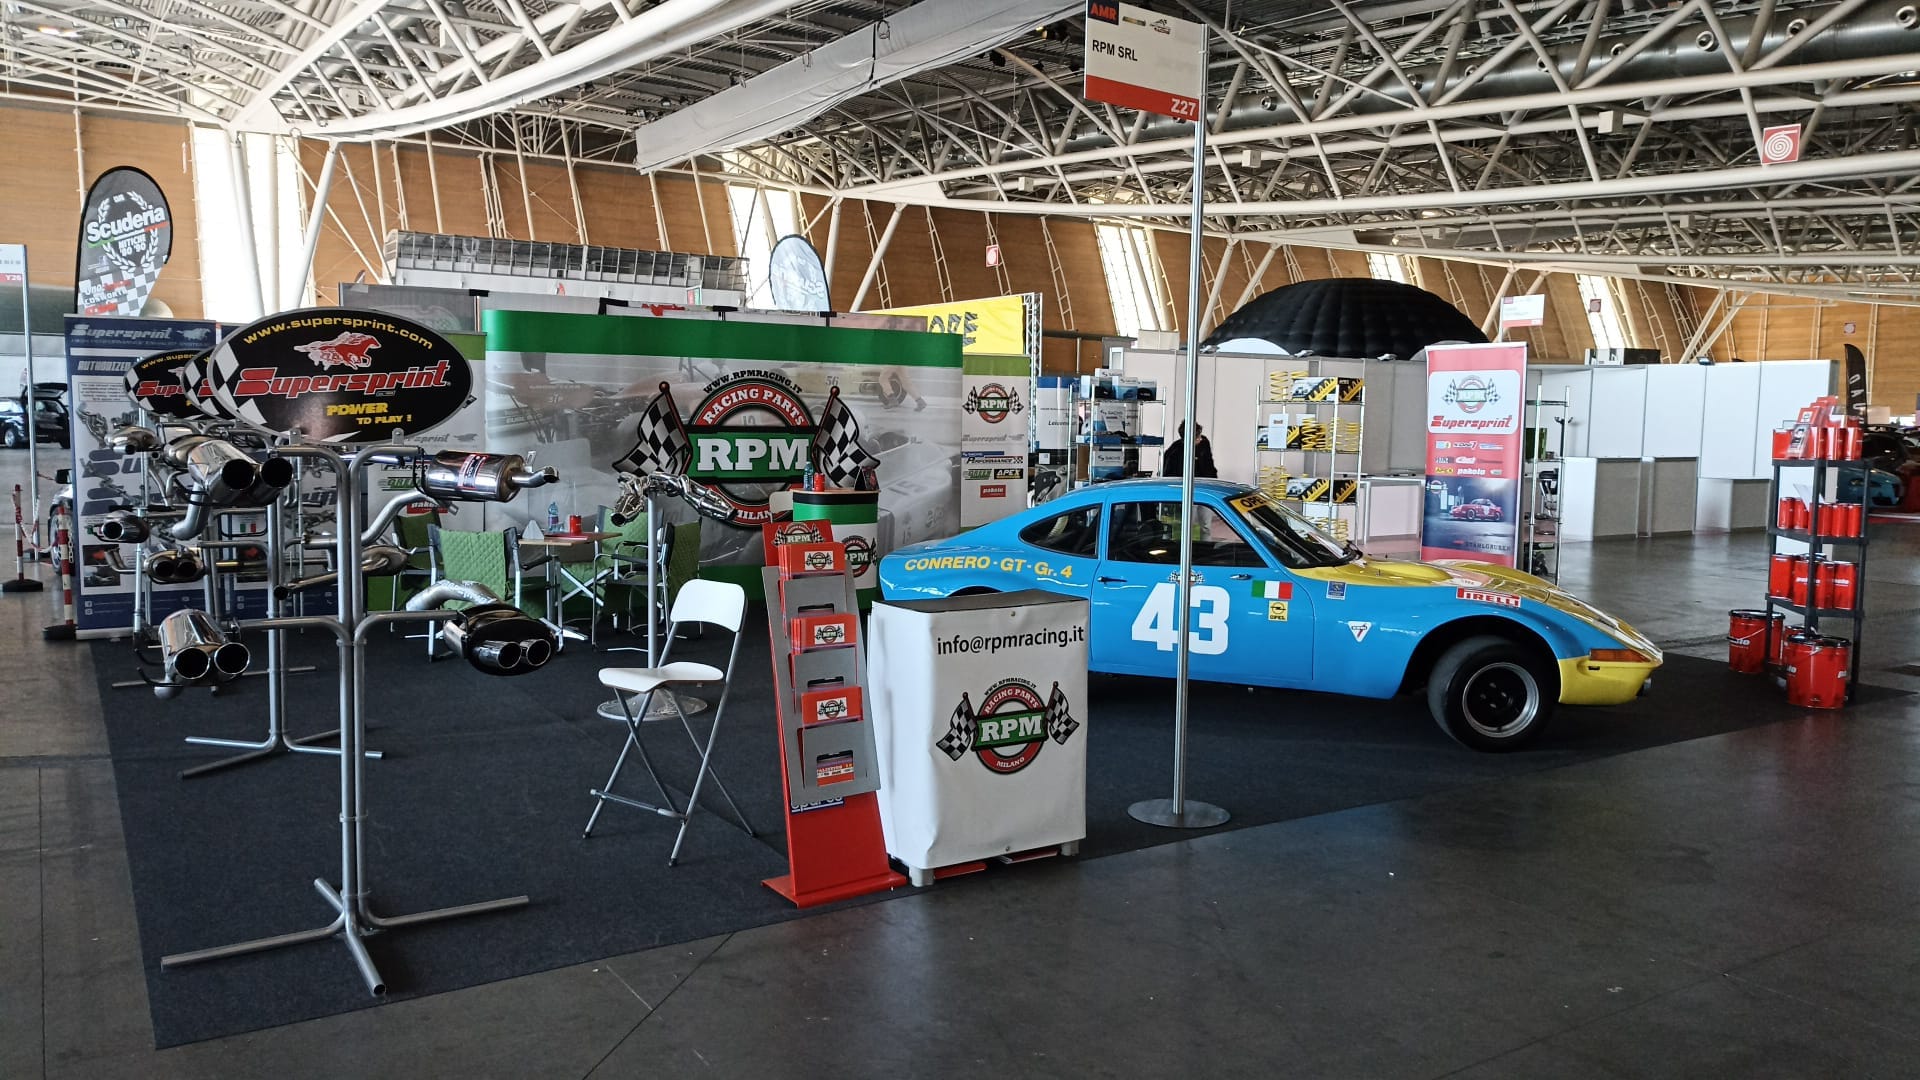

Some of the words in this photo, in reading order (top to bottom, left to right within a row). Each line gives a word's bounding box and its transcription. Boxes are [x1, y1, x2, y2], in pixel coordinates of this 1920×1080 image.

[1090, 5, 1118, 21] AMR
[1092, 39, 1115, 56] RPM
[1118, 46, 1138, 61] SRL
[1171, 98, 1197, 116] Z27
[86, 204, 166, 243] Scuderia
[70, 323, 172, 340] Supersprint
[243, 317, 433, 350] www.supersprint.com
[234, 359, 450, 399] Supersprint
[703, 370, 803, 394] WWW.RPMRACING.IT
[326, 402, 389, 416] POWER
[702, 388, 759, 425] RACING
[762, 388, 806, 426] PARTS
[980, 400, 1008, 409] RPM
[375, 415, 403, 424] PLAY
[1431, 414, 1513, 430] Supersprint
[697, 438, 809, 471] RPM
[786, 534, 811, 543] RPM
[904, 556, 990, 571] CONRERO
[1000, 557, 1024, 573] GT
[1034, 563, 1057, 577] Gr.
[1060, 564, 1073, 578] 4
[1457, 586, 1520, 608] PIRELLI
[1131, 582, 1229, 655] 43
[937, 626, 1085, 655] info@rpmracing.it
[984, 677, 1037, 696] WWW.RPMRACING.IT
[984, 688, 1013, 714] RACING
[1014, 688, 1039, 709] PARTS
[980, 714, 1042, 743] RPM
[996, 756, 1026, 768] MILANO
